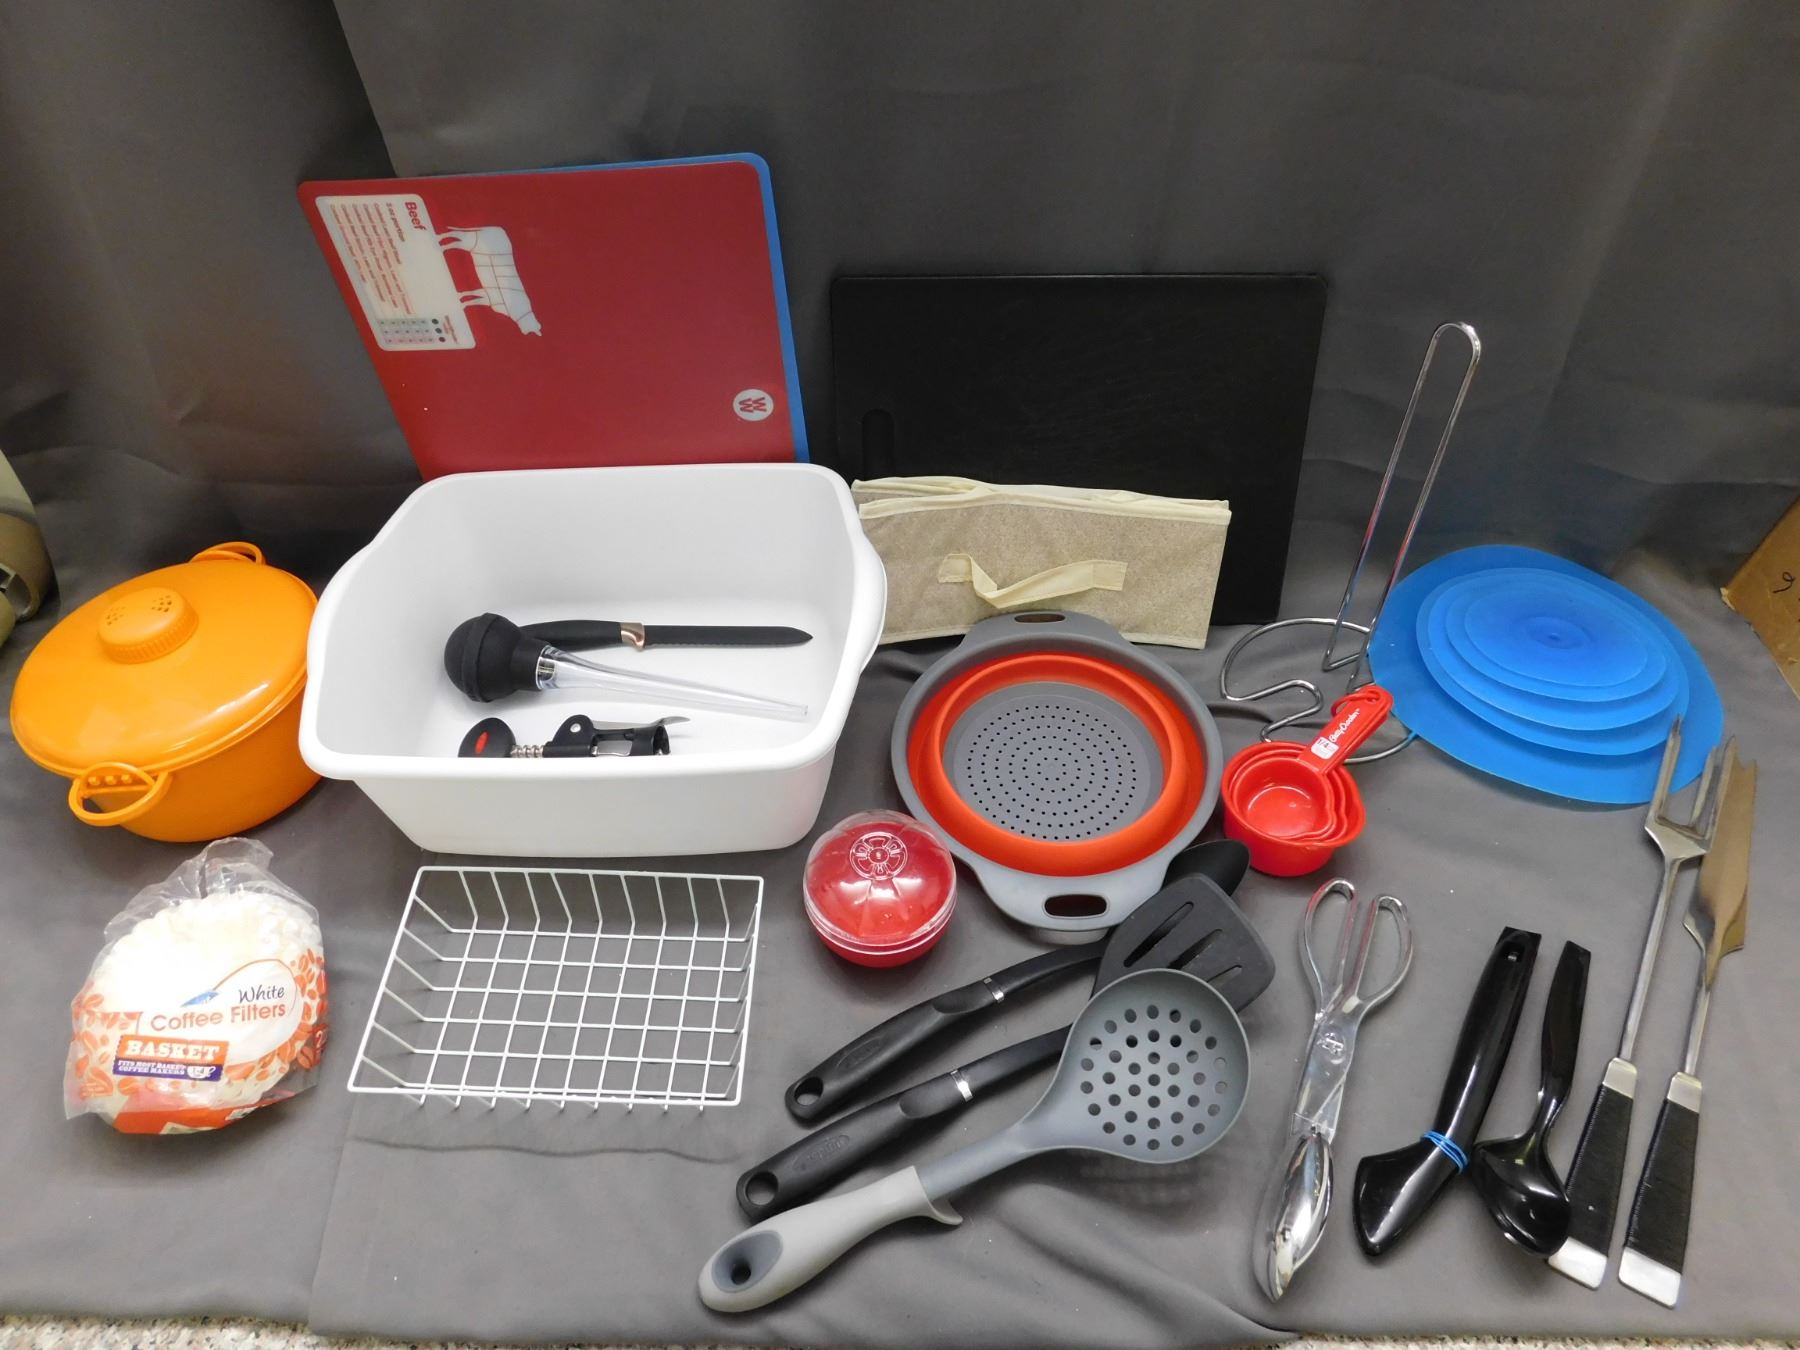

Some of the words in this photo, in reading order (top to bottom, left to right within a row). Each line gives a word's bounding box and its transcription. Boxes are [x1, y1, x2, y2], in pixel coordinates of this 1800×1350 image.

[405, 201, 426, 230] Beef
[238, 984, 285, 1004] White
[150, 1011, 224, 1031] Coffee
[230, 1002, 286, 1023] Filters
[125, 1039, 220, 1061] BASKET
[150, 1067, 185, 1075] MAKERS
